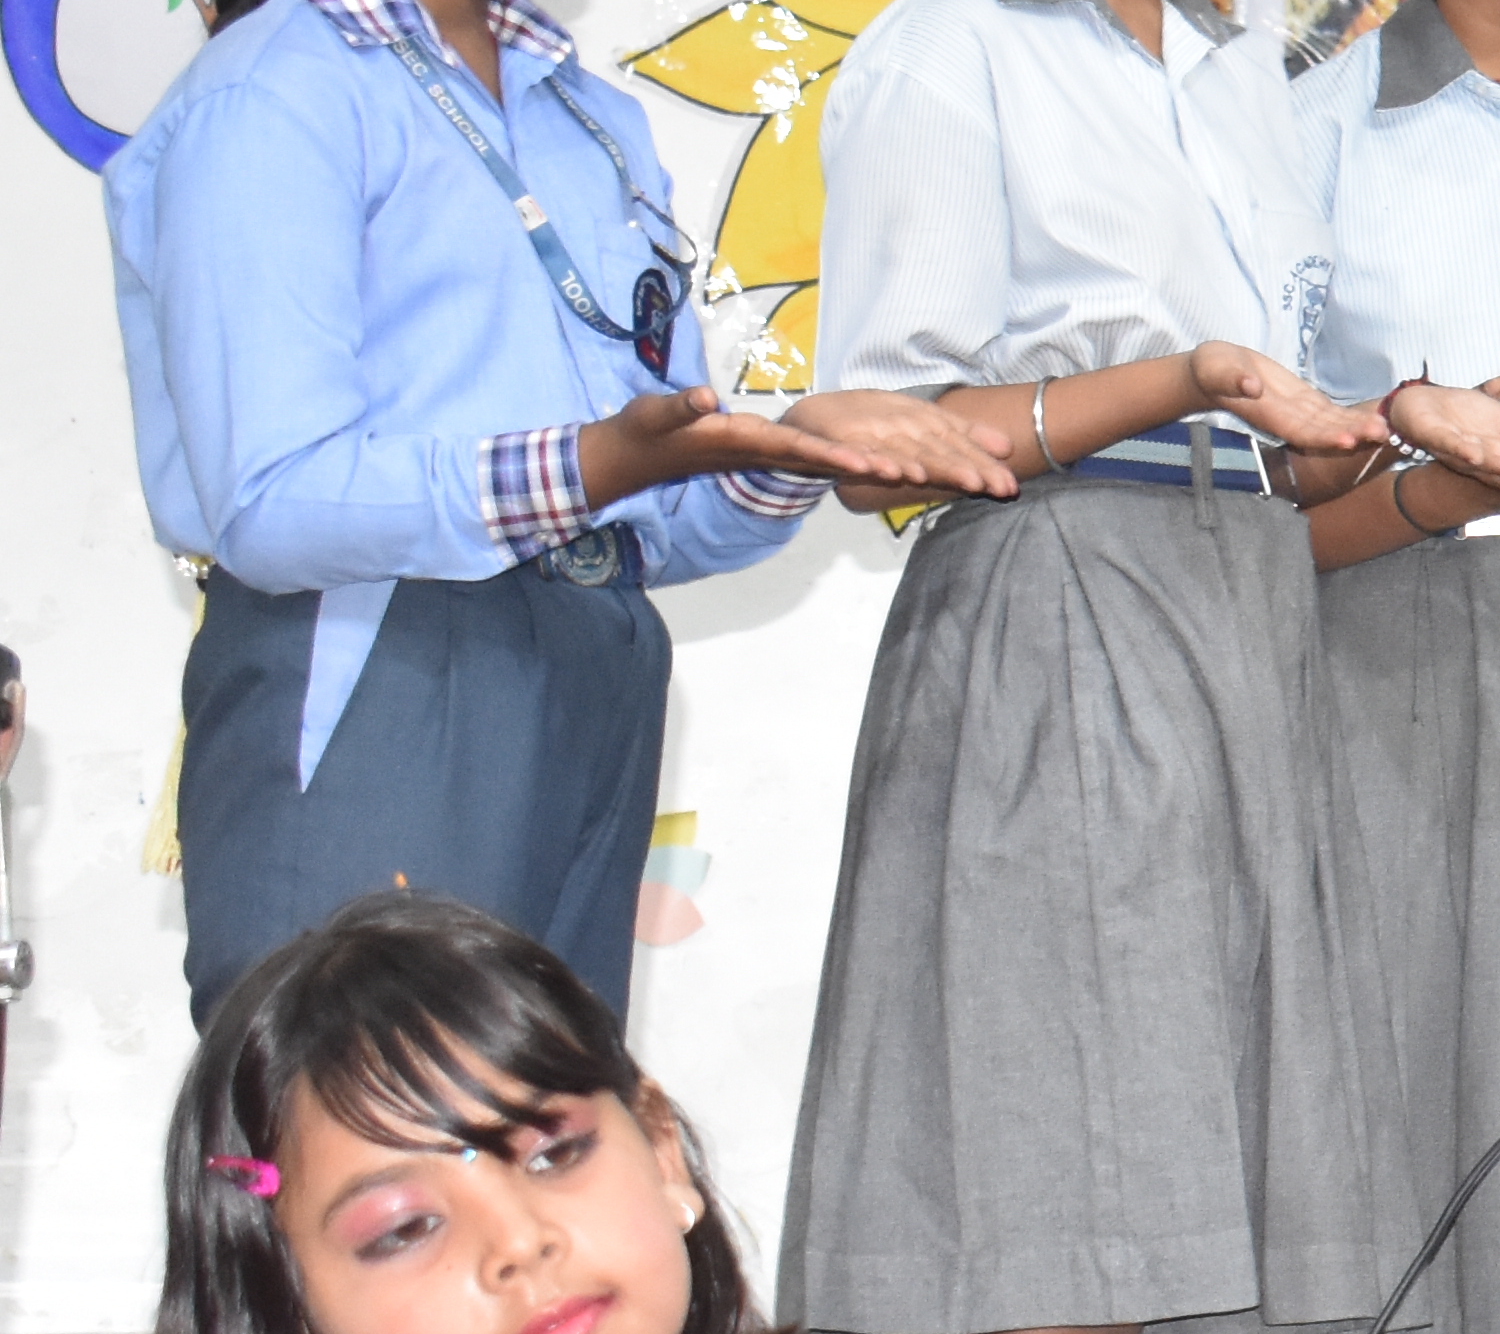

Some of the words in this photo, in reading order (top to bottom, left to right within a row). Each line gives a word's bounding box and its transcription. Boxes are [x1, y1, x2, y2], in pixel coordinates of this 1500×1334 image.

[391, 40, 429, 84] SEC.
[428, 83, 490, 159] SCHOOL
[1282, 283, 1296, 312] SSC
